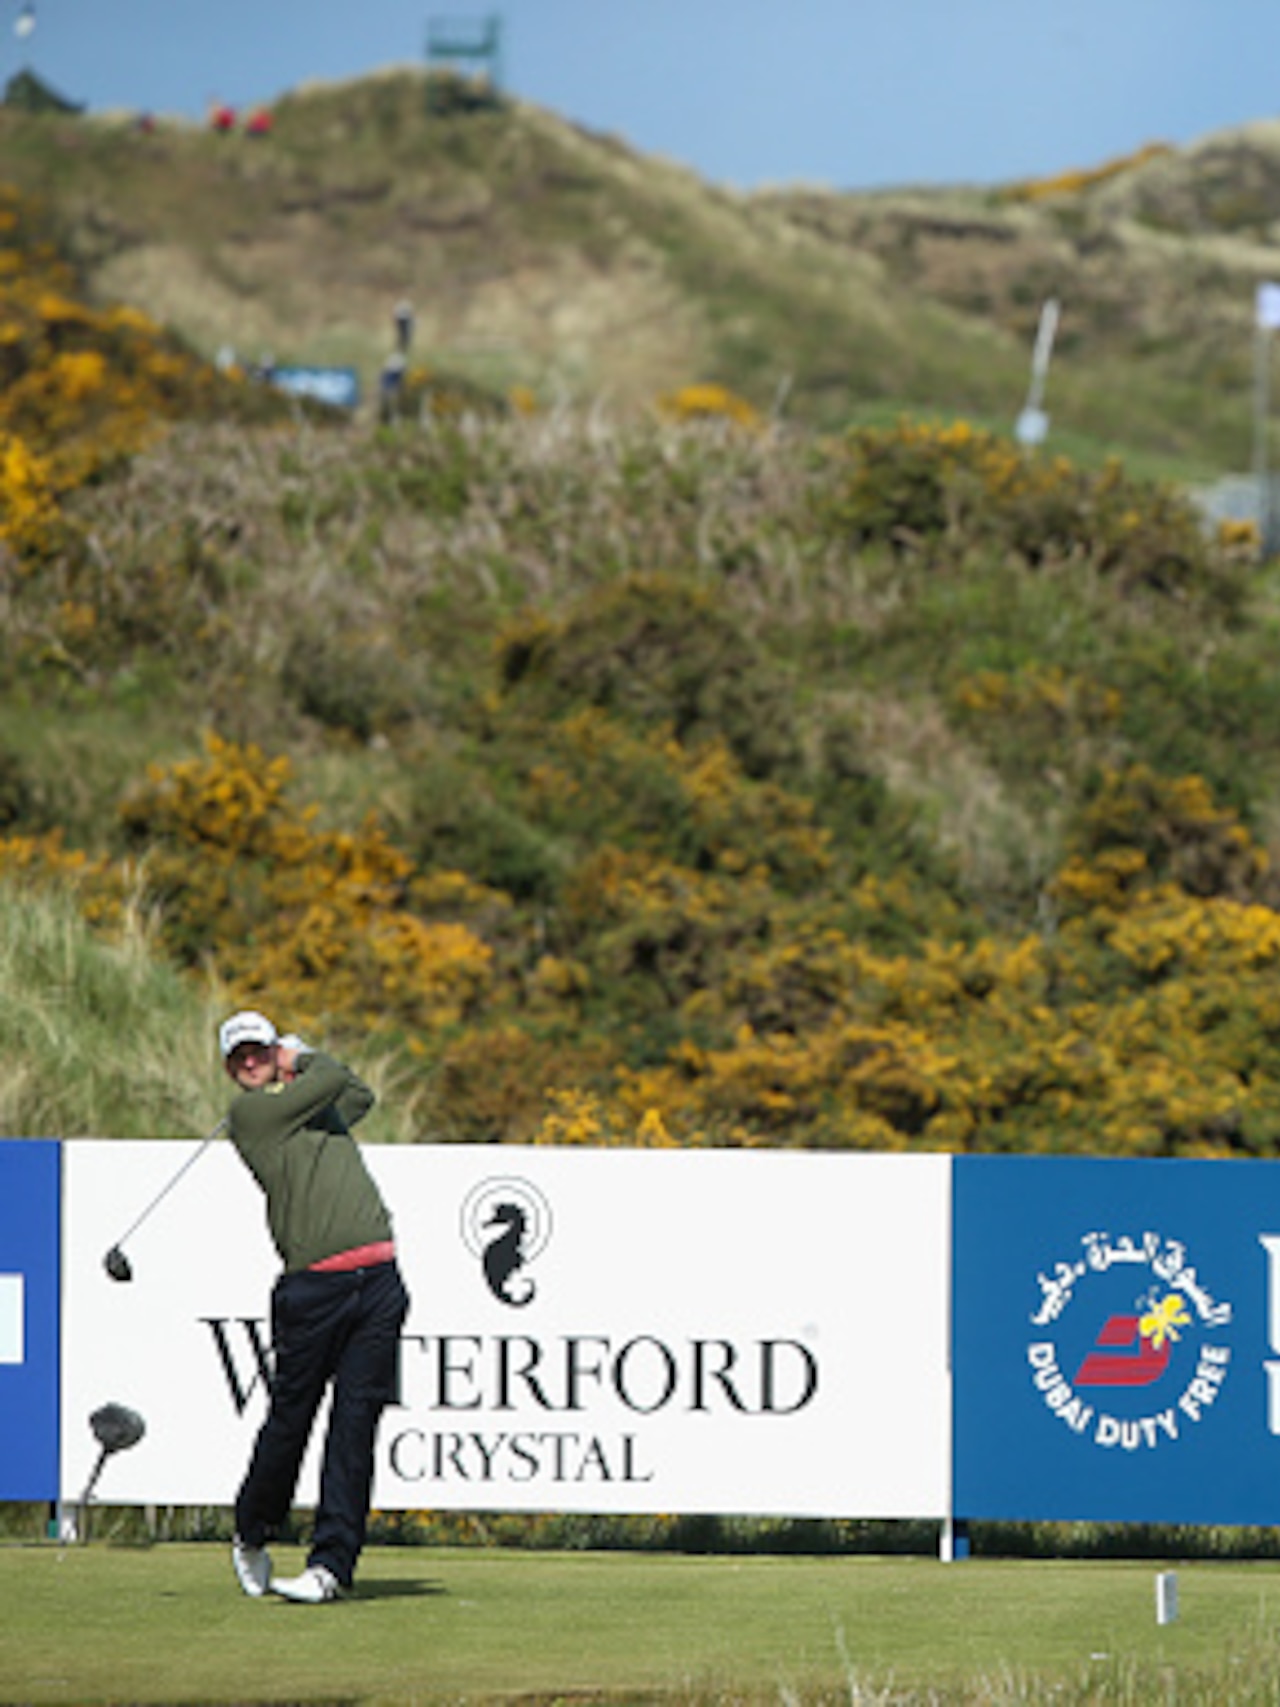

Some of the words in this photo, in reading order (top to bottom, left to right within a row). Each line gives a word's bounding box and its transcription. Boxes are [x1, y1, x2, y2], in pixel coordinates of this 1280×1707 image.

[197, 1317, 820, 1415] WTERFORD
[1027, 1341, 1095, 1433] DUBAI
[1094, 1408, 1179, 1450] DUTY
[1177, 1344, 1232, 1422] FREE
[388, 1431, 654, 1483] CRYSTAL
